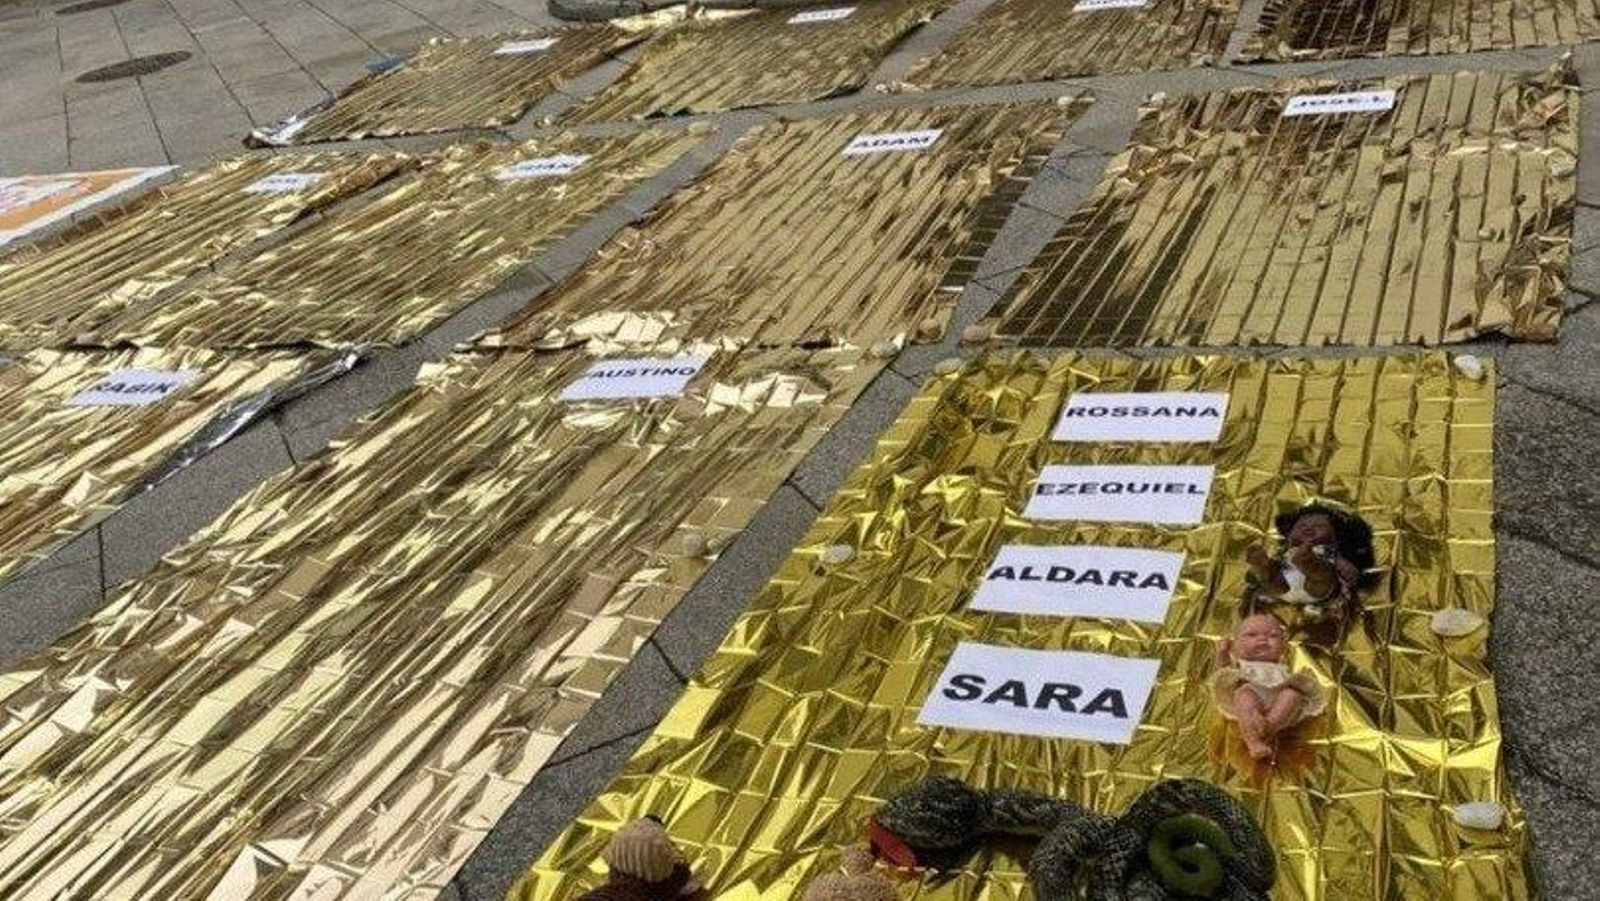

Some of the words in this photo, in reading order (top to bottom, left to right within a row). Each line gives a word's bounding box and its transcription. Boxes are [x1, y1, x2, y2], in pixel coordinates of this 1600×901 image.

[854, 136, 930, 148] ADAM
[1065, 406, 1220, 418] ROSSANA
[1036, 482, 1205, 495] EZEQUIEL
[986, 565, 1170, 591] ALDARA
[942, 674, 1129, 719] SARA
